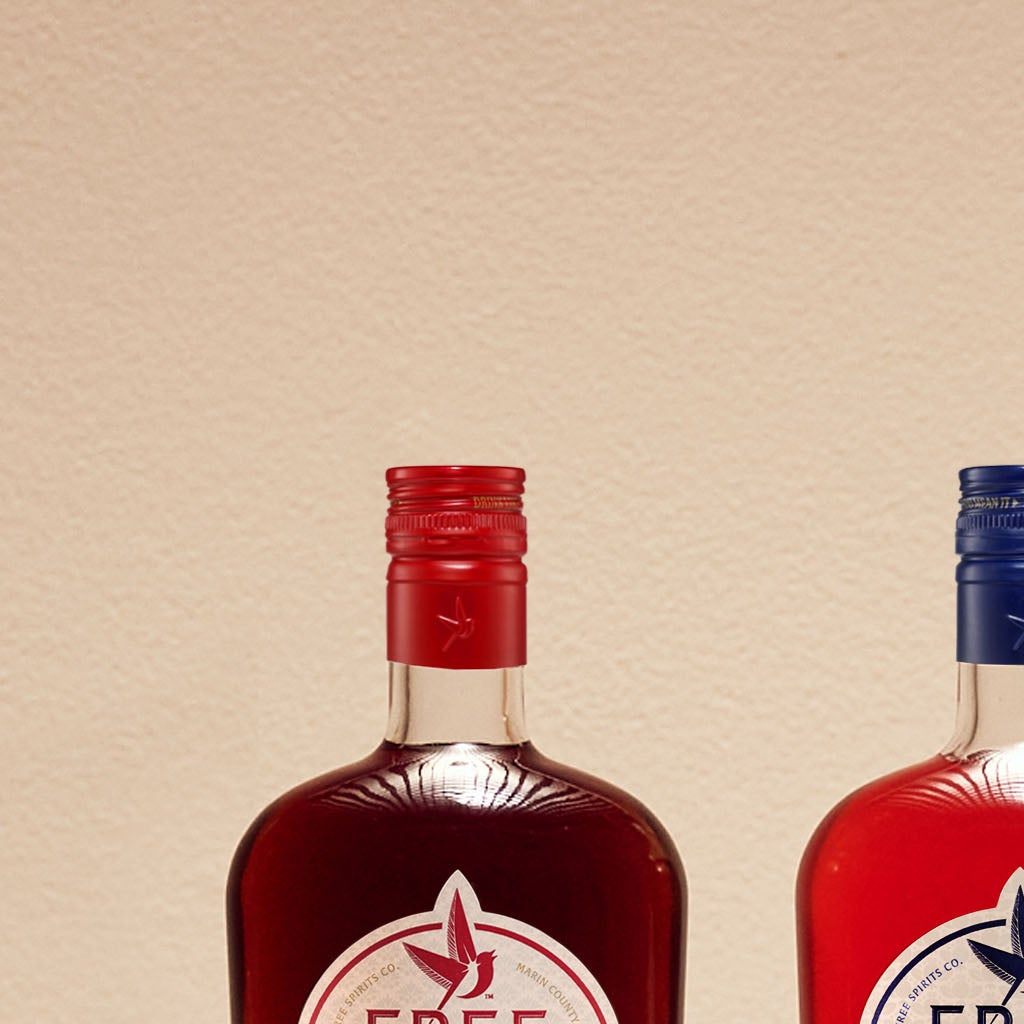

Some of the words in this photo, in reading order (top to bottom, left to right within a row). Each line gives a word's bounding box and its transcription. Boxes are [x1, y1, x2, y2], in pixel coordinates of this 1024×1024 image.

[345, 973, 379, 1007] SPIRITS
[516, 962, 549, 988] MARIN
[908, 968, 943, 1002] SPIRITS
[943, 958, 964, 972] CO.
